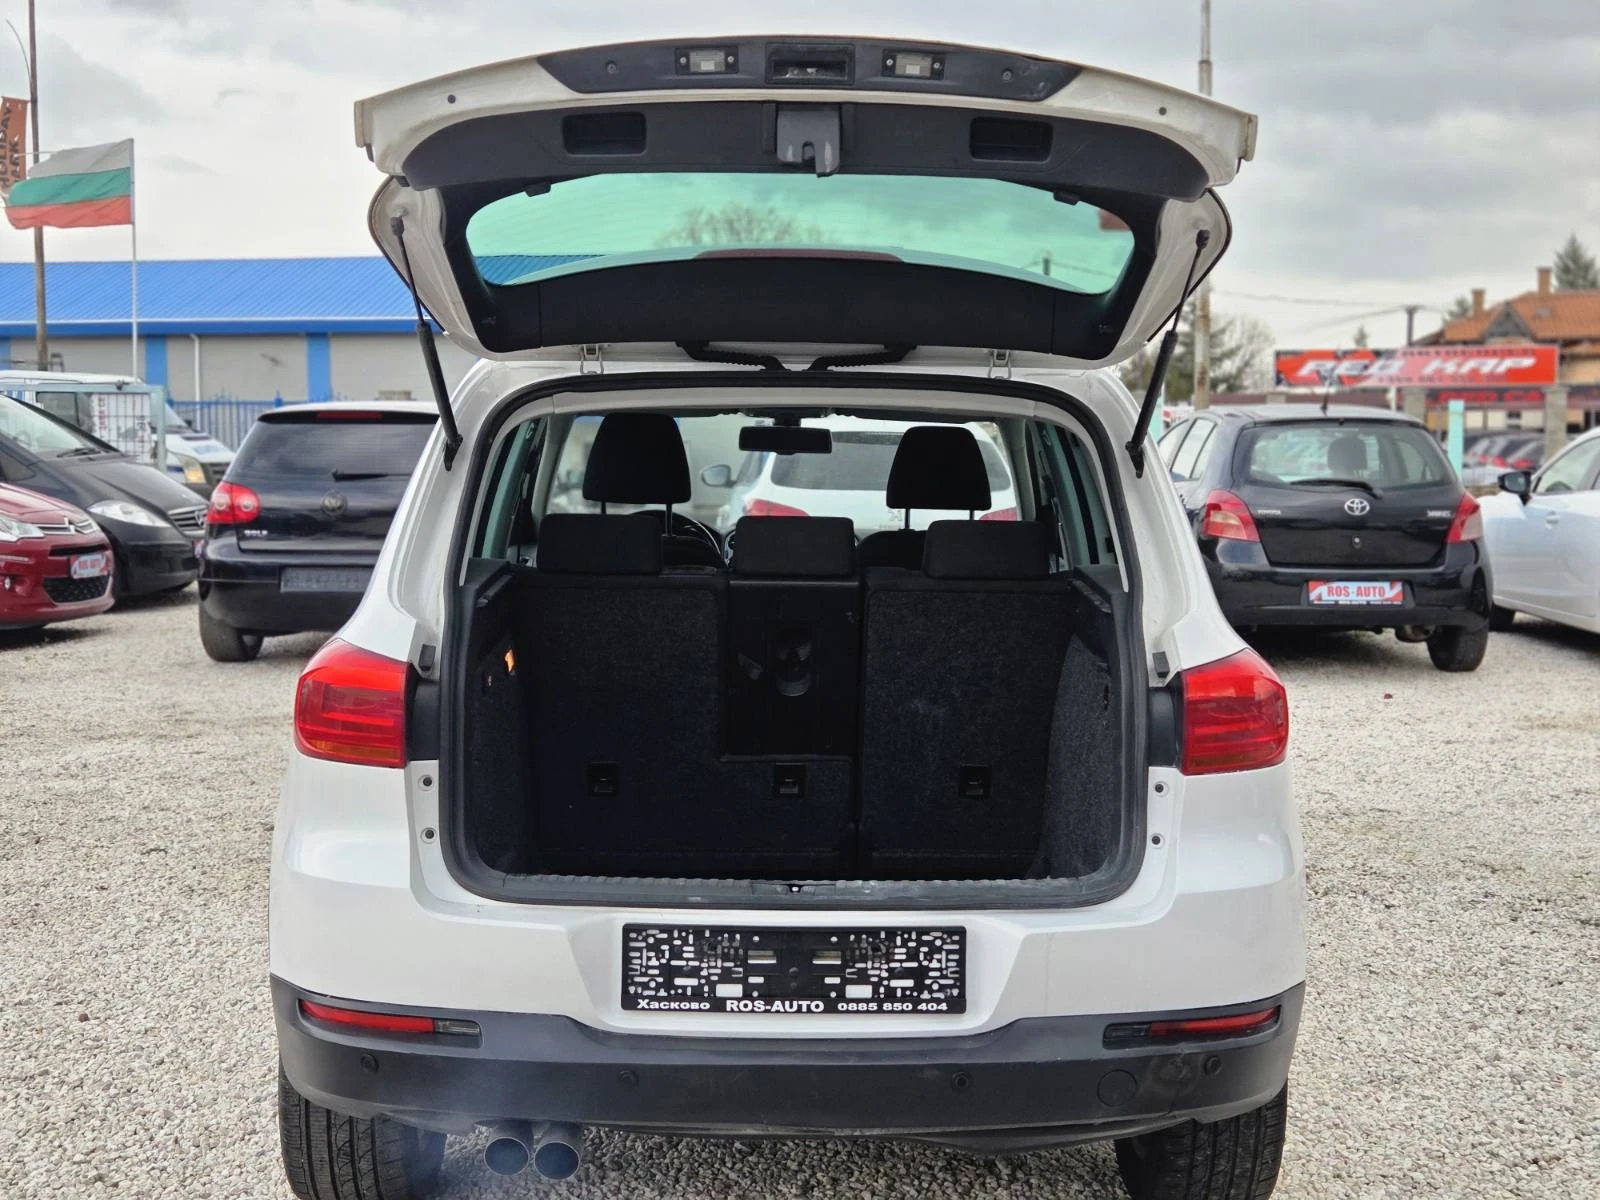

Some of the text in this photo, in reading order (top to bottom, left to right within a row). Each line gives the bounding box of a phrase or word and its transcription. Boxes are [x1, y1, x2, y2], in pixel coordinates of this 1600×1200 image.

[636, 999, 711, 1010] Хасково
[726, 1000, 825, 1012] ROS-AUTO
[837, 1002, 949, 1011] 0885 850 404
